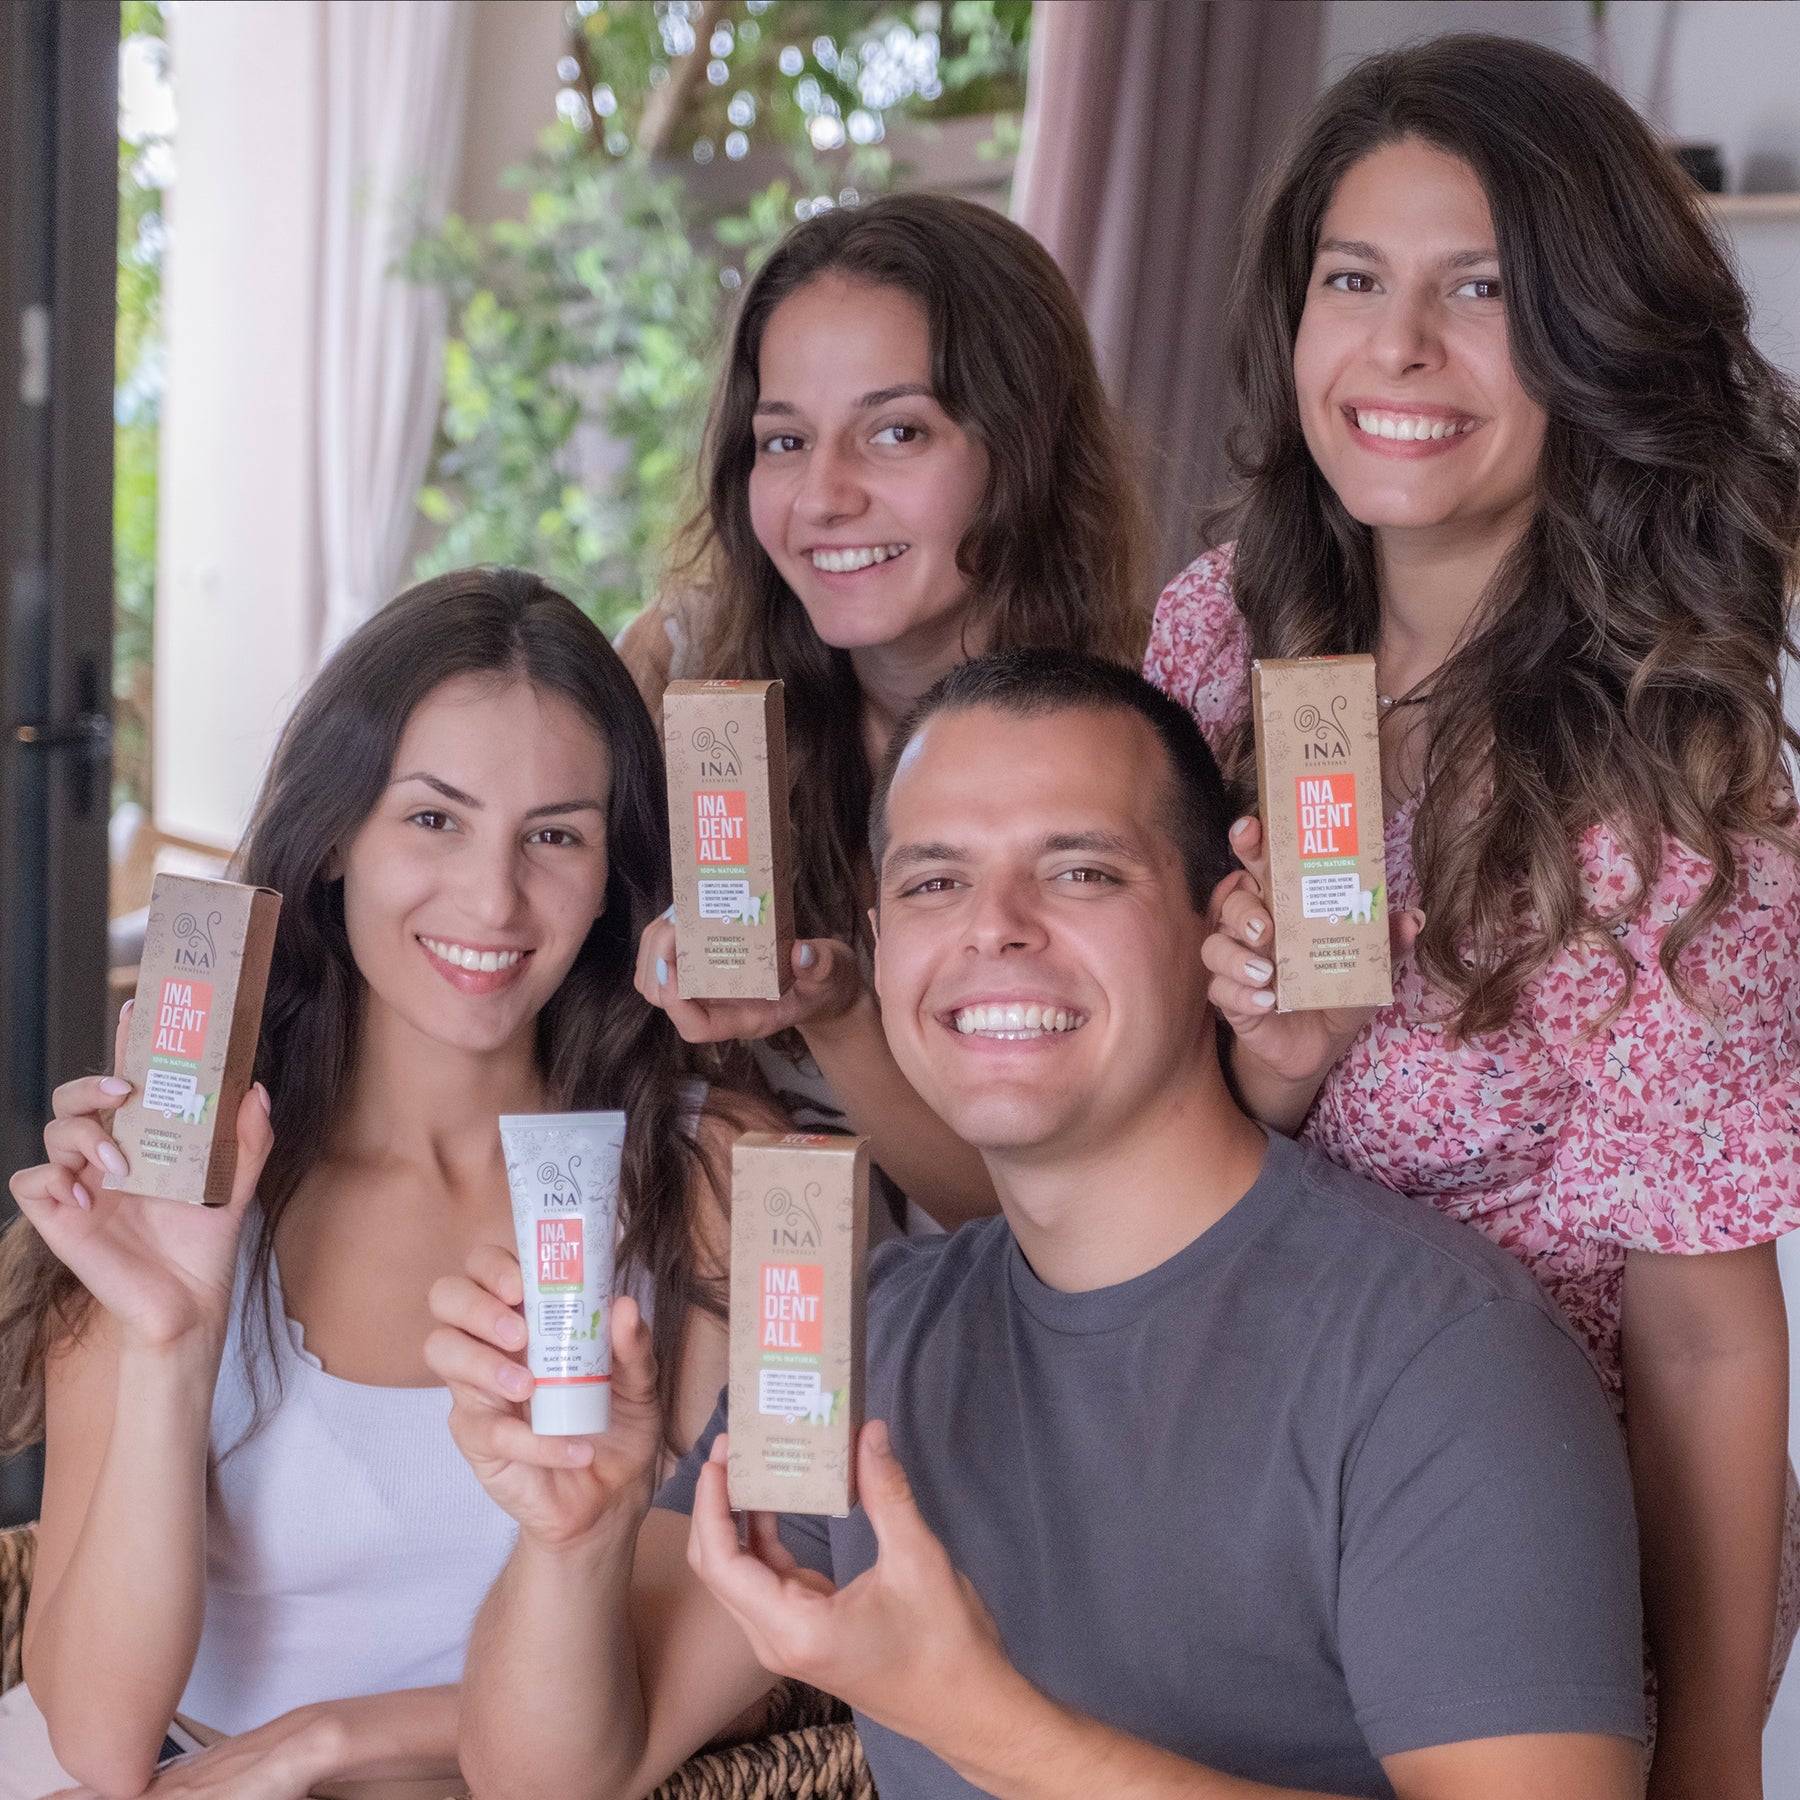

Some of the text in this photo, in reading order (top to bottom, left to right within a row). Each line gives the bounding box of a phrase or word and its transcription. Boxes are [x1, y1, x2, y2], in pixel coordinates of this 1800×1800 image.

[1304, 742, 1346, 759] INA
[701, 762, 737, 776] INA
[1300, 779, 1334, 804] INA
[698, 795, 728, 817] INA
[1302, 803, 1352, 829] DENT
[698, 817, 744, 839] DENT
[700, 840, 732, 861] ALL
[1303, 829, 1339, 854] ALL
[1304, 860, 1356, 869] 100% NATURAL
[1312, 936, 1355, 944] POSTBIOTIC+
[175, 948, 210, 968] INA
[163, 982, 192, 1008] INA
[160, 1004, 206, 1032] DENT
[155, 1028, 186, 1054] ALL
[152, 1055, 197, 1070] 100% NATURAL
[144, 1128, 182, 1140] POSTBIOTIC+
[140, 1139, 158, 1148] BLACK
[172, 1144, 183, 1152] LYE
[140, 1151, 161, 1160] SMOKE
[163, 1154, 178, 1164] TREE
[544, 1192, 577, 1206] INA
[541, 1223, 566, 1242] INA
[772, 1229, 816, 1248] INA
[541, 1242, 580, 1262] DENT
[541, 1262, 568, 1280] ALL
[766, 1268, 800, 1294] INA
[765, 1294, 819, 1322] DENT
[764, 1321, 802, 1348] ALL
[784, 1356, 818, 1364] NATURAL
